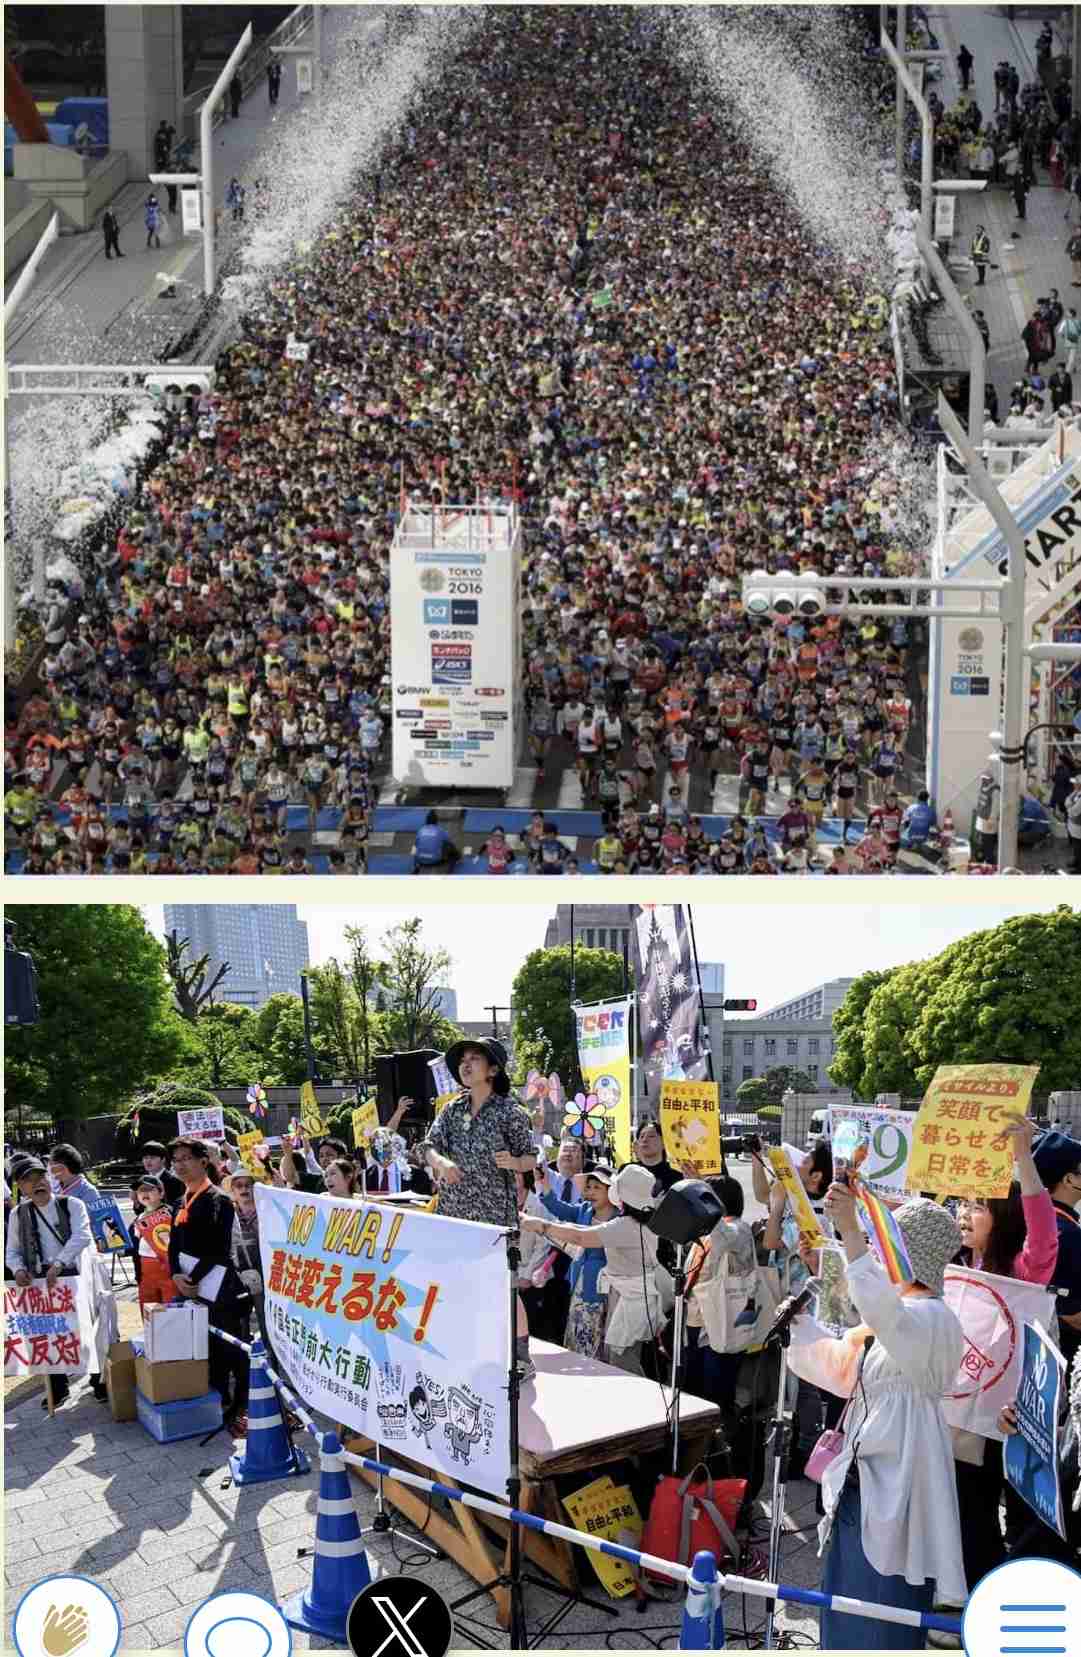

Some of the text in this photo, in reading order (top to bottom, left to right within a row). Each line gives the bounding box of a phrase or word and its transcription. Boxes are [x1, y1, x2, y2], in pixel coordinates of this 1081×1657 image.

[448, 567, 482, 577] TOKYO
[448, 582, 483, 594] 2016
[663, 1096, 715, 1112] 自由と平和
[919, 1122, 1009, 1153] 暮らせる
[927, 1152, 993, 1178] 日常を
[286, 1204, 316, 1246] NO
[1031, 1353, 1048, 1391] NO
[1022, 1375, 1046, 1428] WAR
